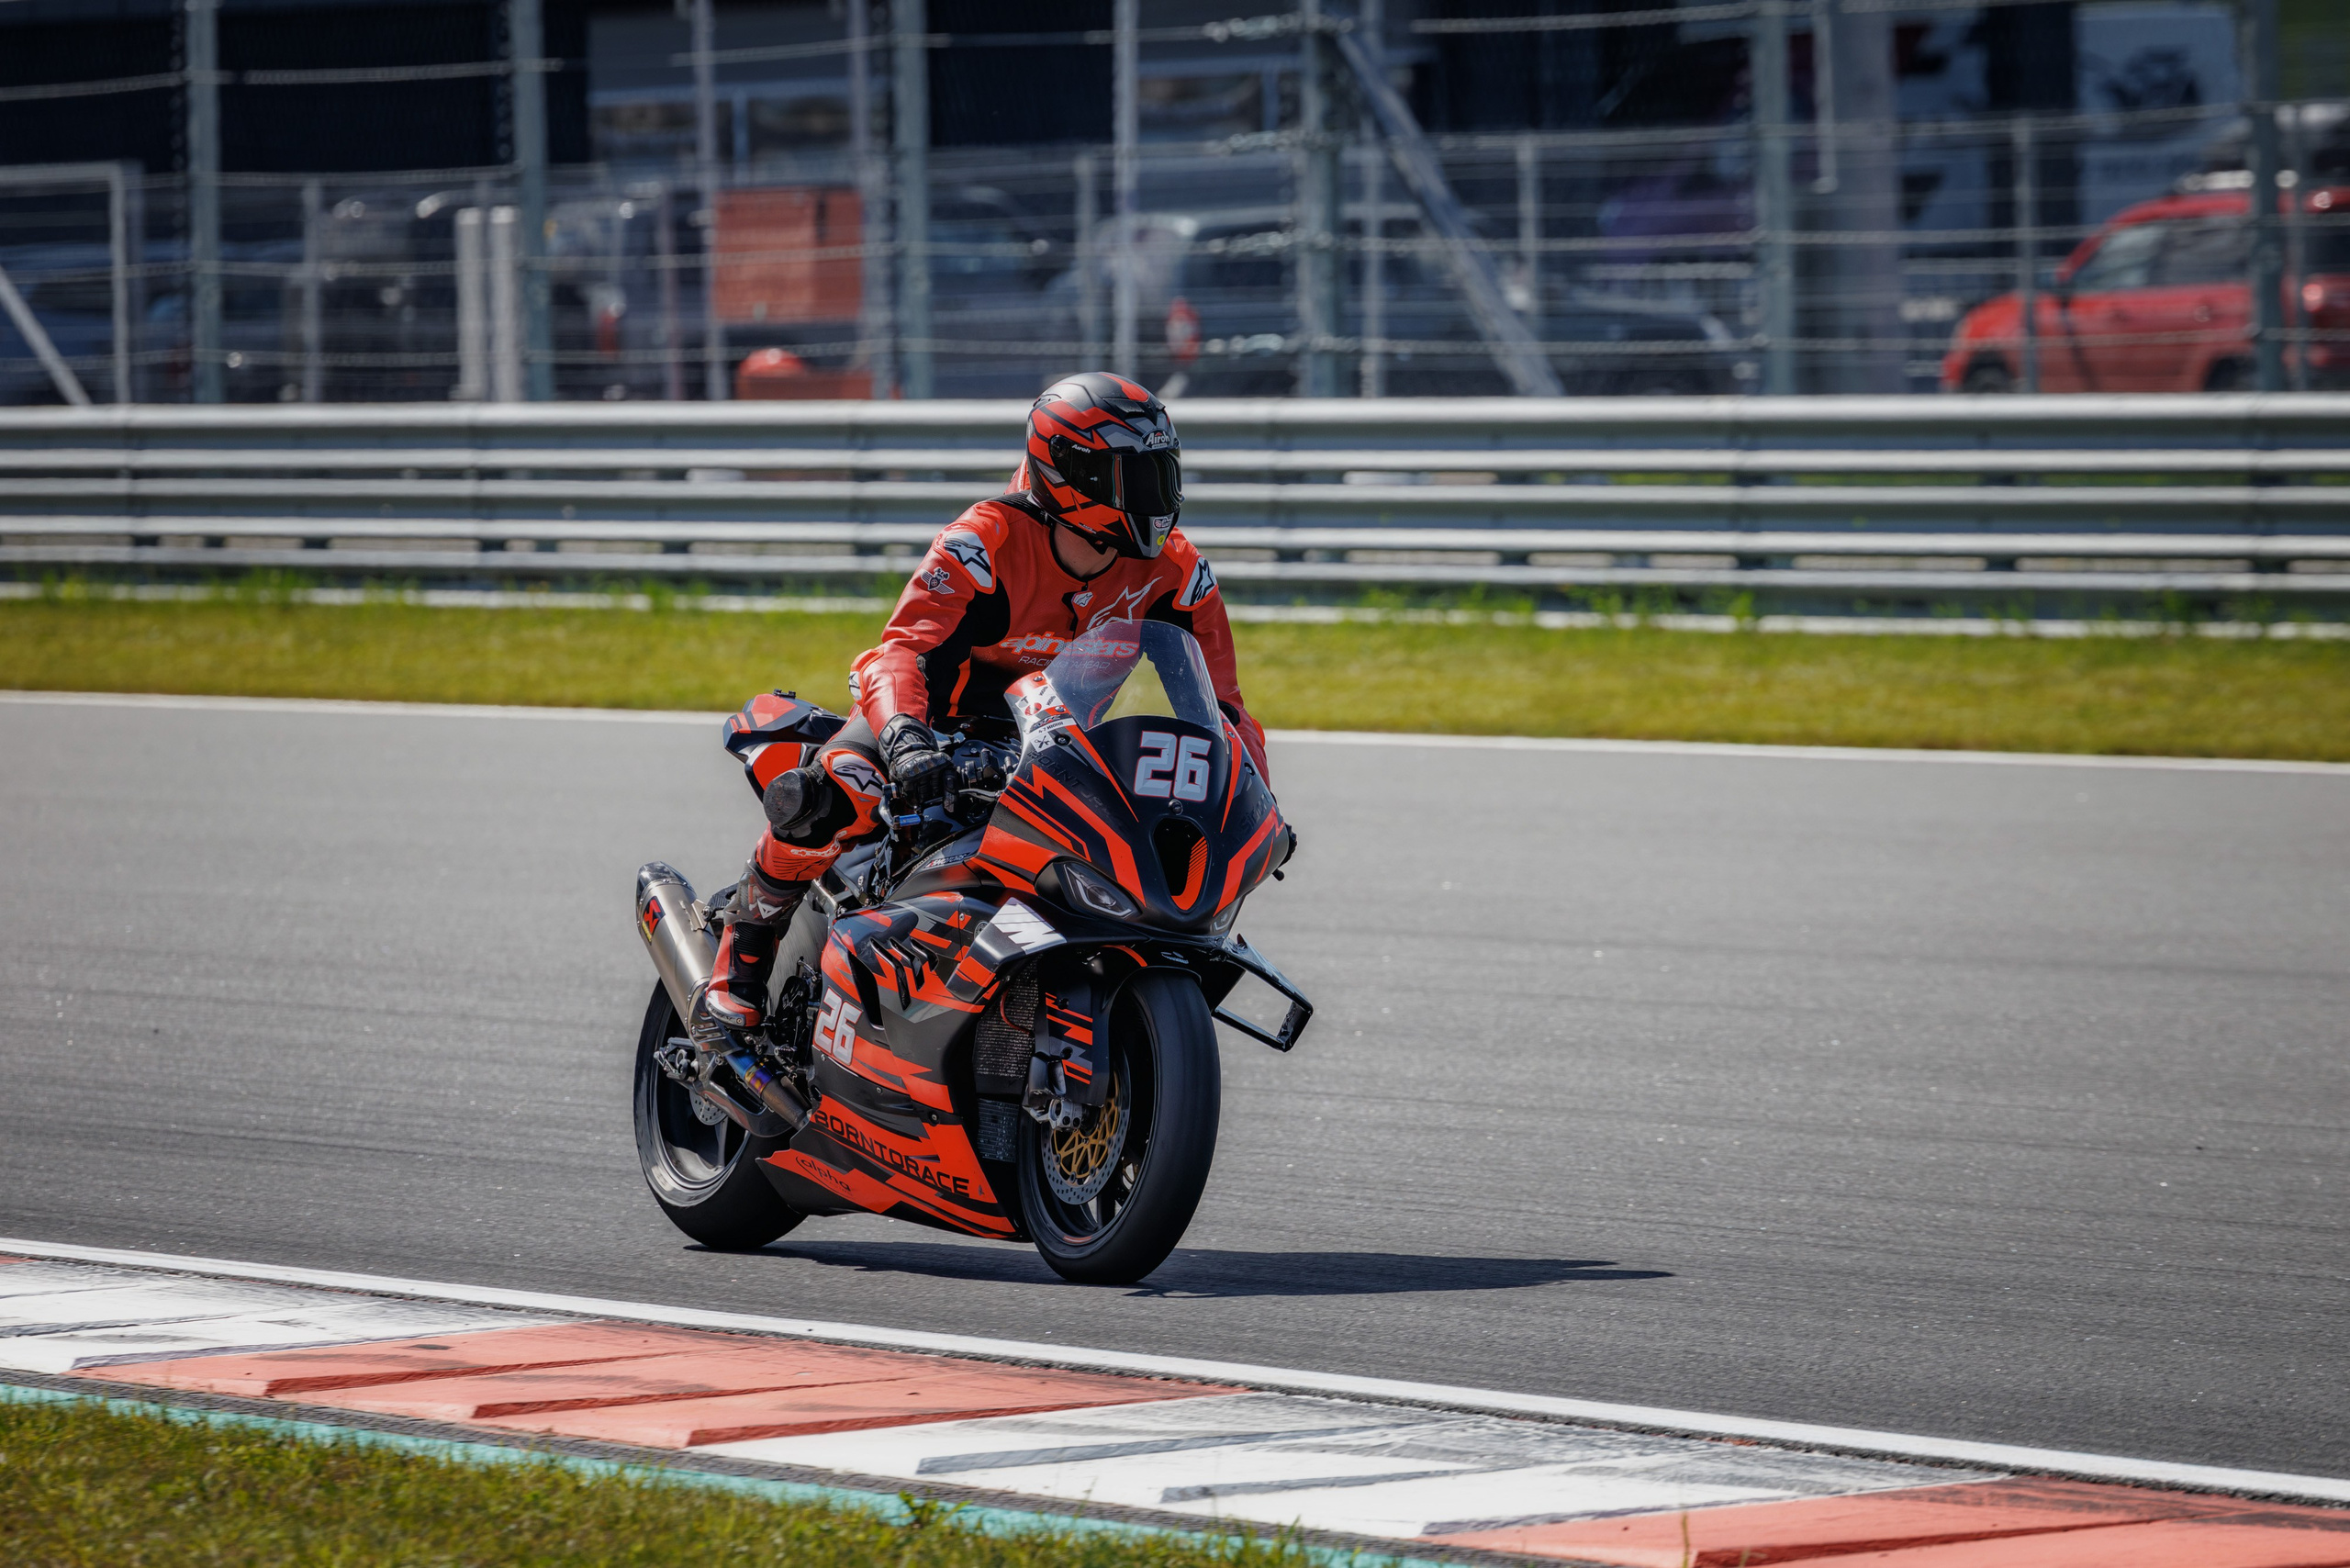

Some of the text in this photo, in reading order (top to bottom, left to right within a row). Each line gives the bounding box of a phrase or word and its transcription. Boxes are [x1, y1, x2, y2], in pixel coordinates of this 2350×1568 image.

[1071, 443, 1091, 454] Airoh
[1145, 431, 1170, 446] Airoh
[1134, 730, 1212, 802] 26
[814, 987, 863, 1066] 26
[800, 1159, 852, 1193] alpha
